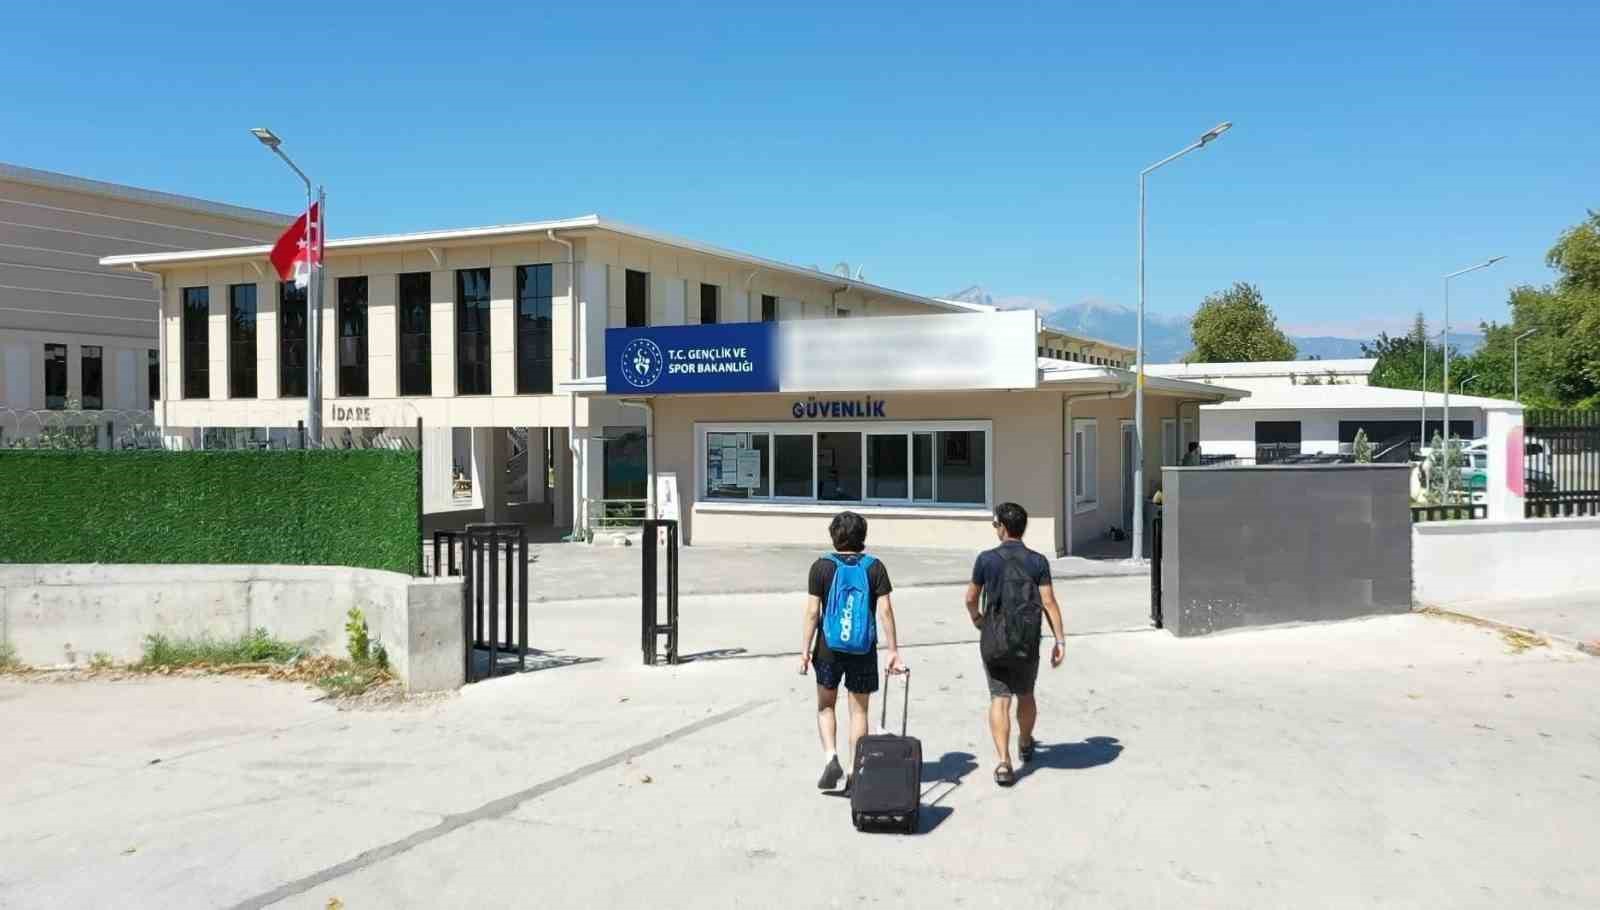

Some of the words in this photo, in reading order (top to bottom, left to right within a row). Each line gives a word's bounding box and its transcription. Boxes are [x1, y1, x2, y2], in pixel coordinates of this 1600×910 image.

[668, 350, 687, 360] T.C.
[688, 348, 732, 361] GENÇLİK
[733, 348, 747, 358] VE
[668, 363, 695, 374] SPOR
[697, 361, 753, 374] BAKANLIĞI
[792, 395, 886, 418] GÜVENLİK
